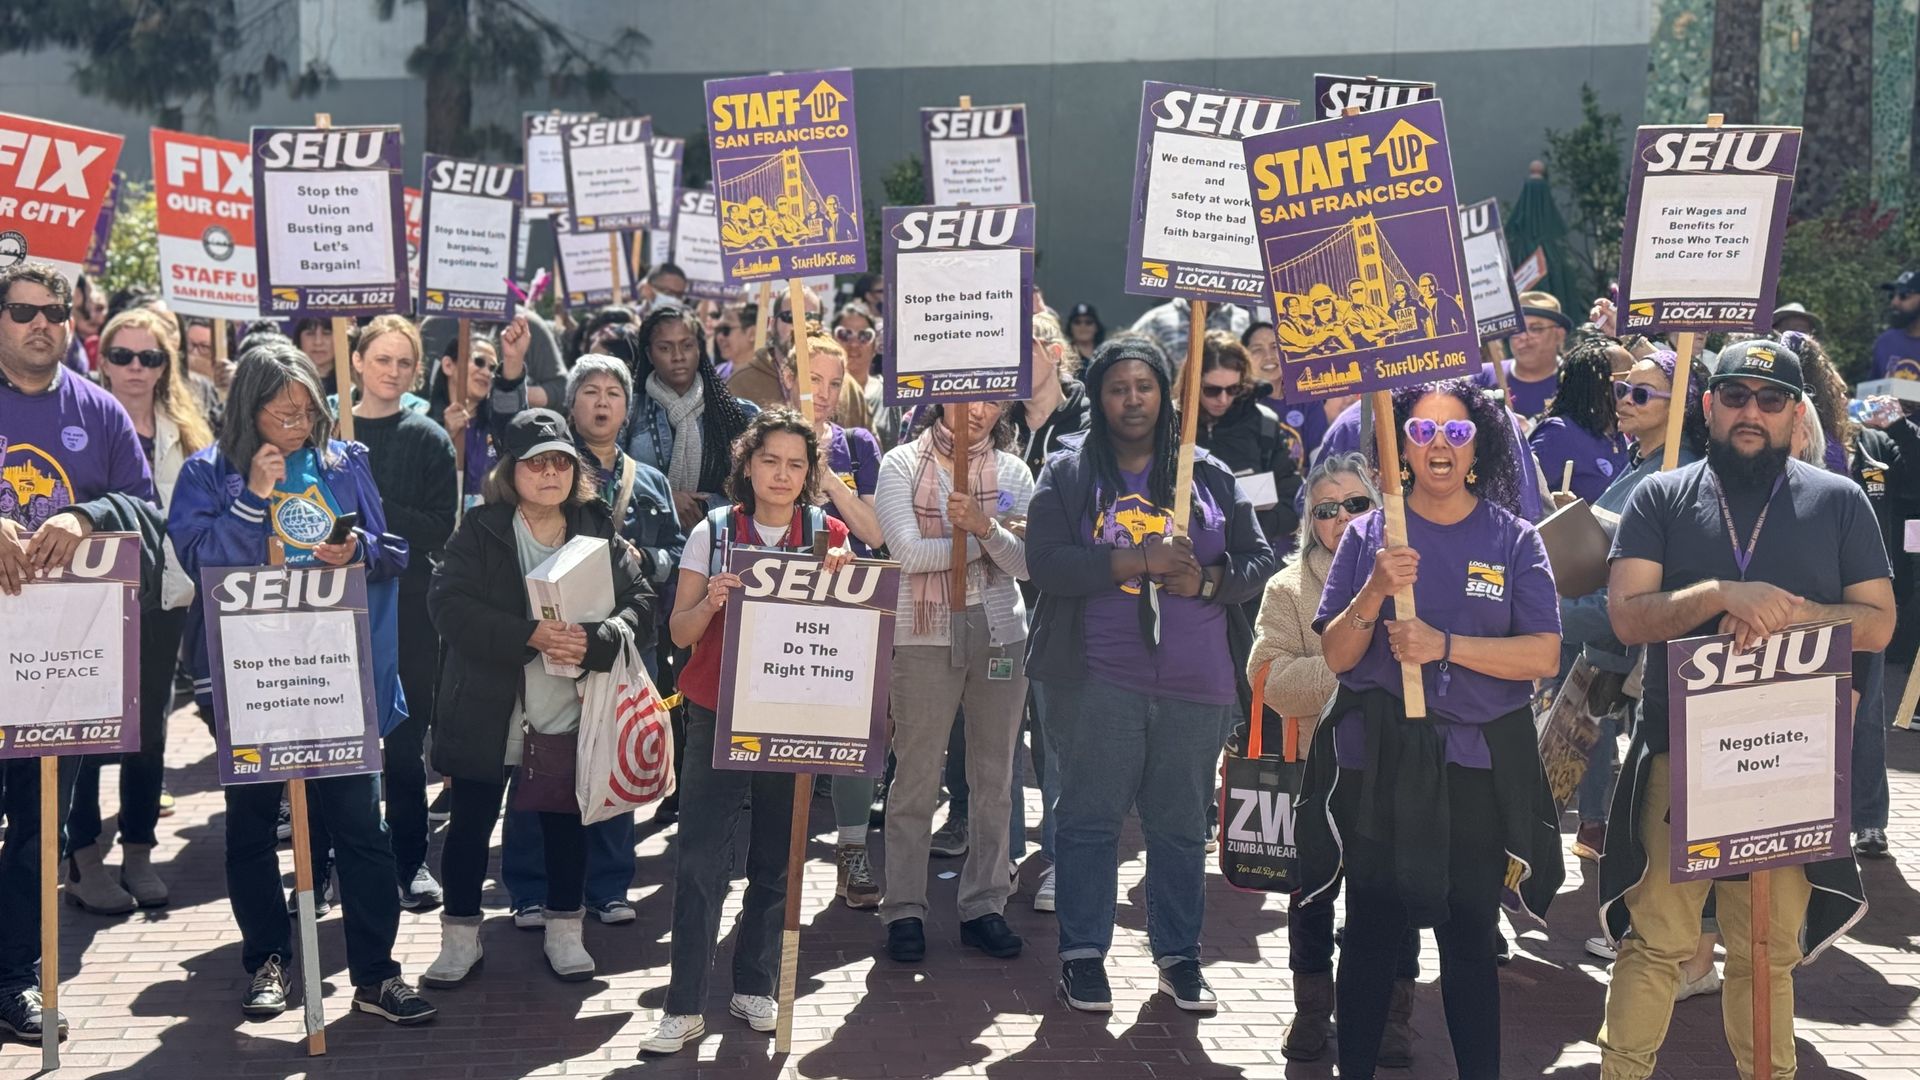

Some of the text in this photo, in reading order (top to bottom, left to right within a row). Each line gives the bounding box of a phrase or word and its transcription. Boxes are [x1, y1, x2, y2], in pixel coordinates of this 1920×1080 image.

[712, 89, 837, 132] STAFF UP
[1156, 90, 1284, 138] SEIU
[930, 109, 1012, 138] SEIU
[569, 120, 641, 147] SEIU
[715, 125, 849, 149] SAN FRANCISCO
[265, 131, 385, 168] SEIU
[1647, 132, 1783, 172] SEIU
[165, 141, 253, 197] FIX
[1161, 153, 1178, 163] We
[1182, 155, 1226, 169] demand
[1253, 133, 1423, 201] STAFF UP
[432, 160, 514, 196] SEIU
[1204, 176, 1225, 186] and
[297, 185, 359, 199] Stop the
[1171, 191, 1206, 204] safety
[1209, 195, 1220, 204] at
[1259, 175, 1443, 225] SAN FRANCISCO
[167, 193, 254, 221] OUR CIT
[308, 204, 350, 215] Union
[680, 192, 717, 217] SE
[1661, 206, 1747, 219] Fair Wages and
[21, 200, 86, 228] CITY
[1176, 208, 1246, 225] Stop the bad
[287, 222, 374, 236] Busting and
[434, 225, 453, 236] Stop
[456, 227, 469, 236] the
[488, 230, 506, 239] faith
[898, 208, 1018, 249] SEIU
[1669, 221, 1734, 230] Benefits for
[1163, 226, 1254, 245] faith bargaining!
[1651, 235, 1749, 245] Those Who Teach
[438, 257, 477, 267] negotiate
[1655, 250, 1740, 260] and Care for SF
[300, 260, 361, 273] Bargain!
[171, 263, 257, 288] STAFF U
[1140, 276, 1168, 288] SEIU
[1175, 272, 1227, 289] LOCAL
[1231, 278, 1265, 293] 1021
[172, 285, 258, 303] SAN FRANCIS
[307, 292, 395, 305] LOCAL 1021
[904, 290, 1013, 305] Stop the bad faith
[272, 301, 299, 310] SEIU
[447, 298, 506, 311] LOCAL 1021
[924, 310, 993, 323] bargaining,
[1396, 309, 1413, 320] FAIR
[1660, 307, 1756, 320] LOCAL 1021
[1478, 318, 1517, 335] OCAL 1021
[1627, 316, 1654, 328] SEIU
[913, 327, 1004, 343] negotiate now!
[1744, 357, 1774, 369] SEIU
[931, 376, 1018, 392] LOCAL 1021
[896, 388, 924, 399] SEIU
[1469, 561, 1491, 570] LOCAL
[745, 558, 882, 603] SEIU
[220, 567, 348, 612] SEIU
[1466, 582, 1504, 596] SEIU
[795, 621, 830, 635] HSH
[783, 642, 838, 656] Do The
[232, 653, 351, 671] Stop the bad faith
[1687, 626, 1833, 691] SEIU
[763, 662, 854, 682] Right Thing
[256, 675, 330, 690] bargaining,
[246, 694, 345, 712] negotiate now!
[15, 725, 121, 743] LOCAL 1021
[1719, 729, 1809, 752] Negotiate,
[270, 750, 322, 766] LOCAL
[327, 746, 363, 761] 1021
[729, 751, 760, 761] SEIU
[769, 744, 866, 762] LOCAL 1021
[233, 763, 261, 774] SEIU
[1737, 755, 1780, 773] Now!
[1228, 840, 1297, 859] ZUMBA WEAR
[1729, 838, 1789, 860] LOCAL
[1794, 830, 1833, 849] 1021
[1236, 863, 1250, 873] For
[1276, 868, 1288, 878] all
[1687, 858, 1720, 873] SEIU
